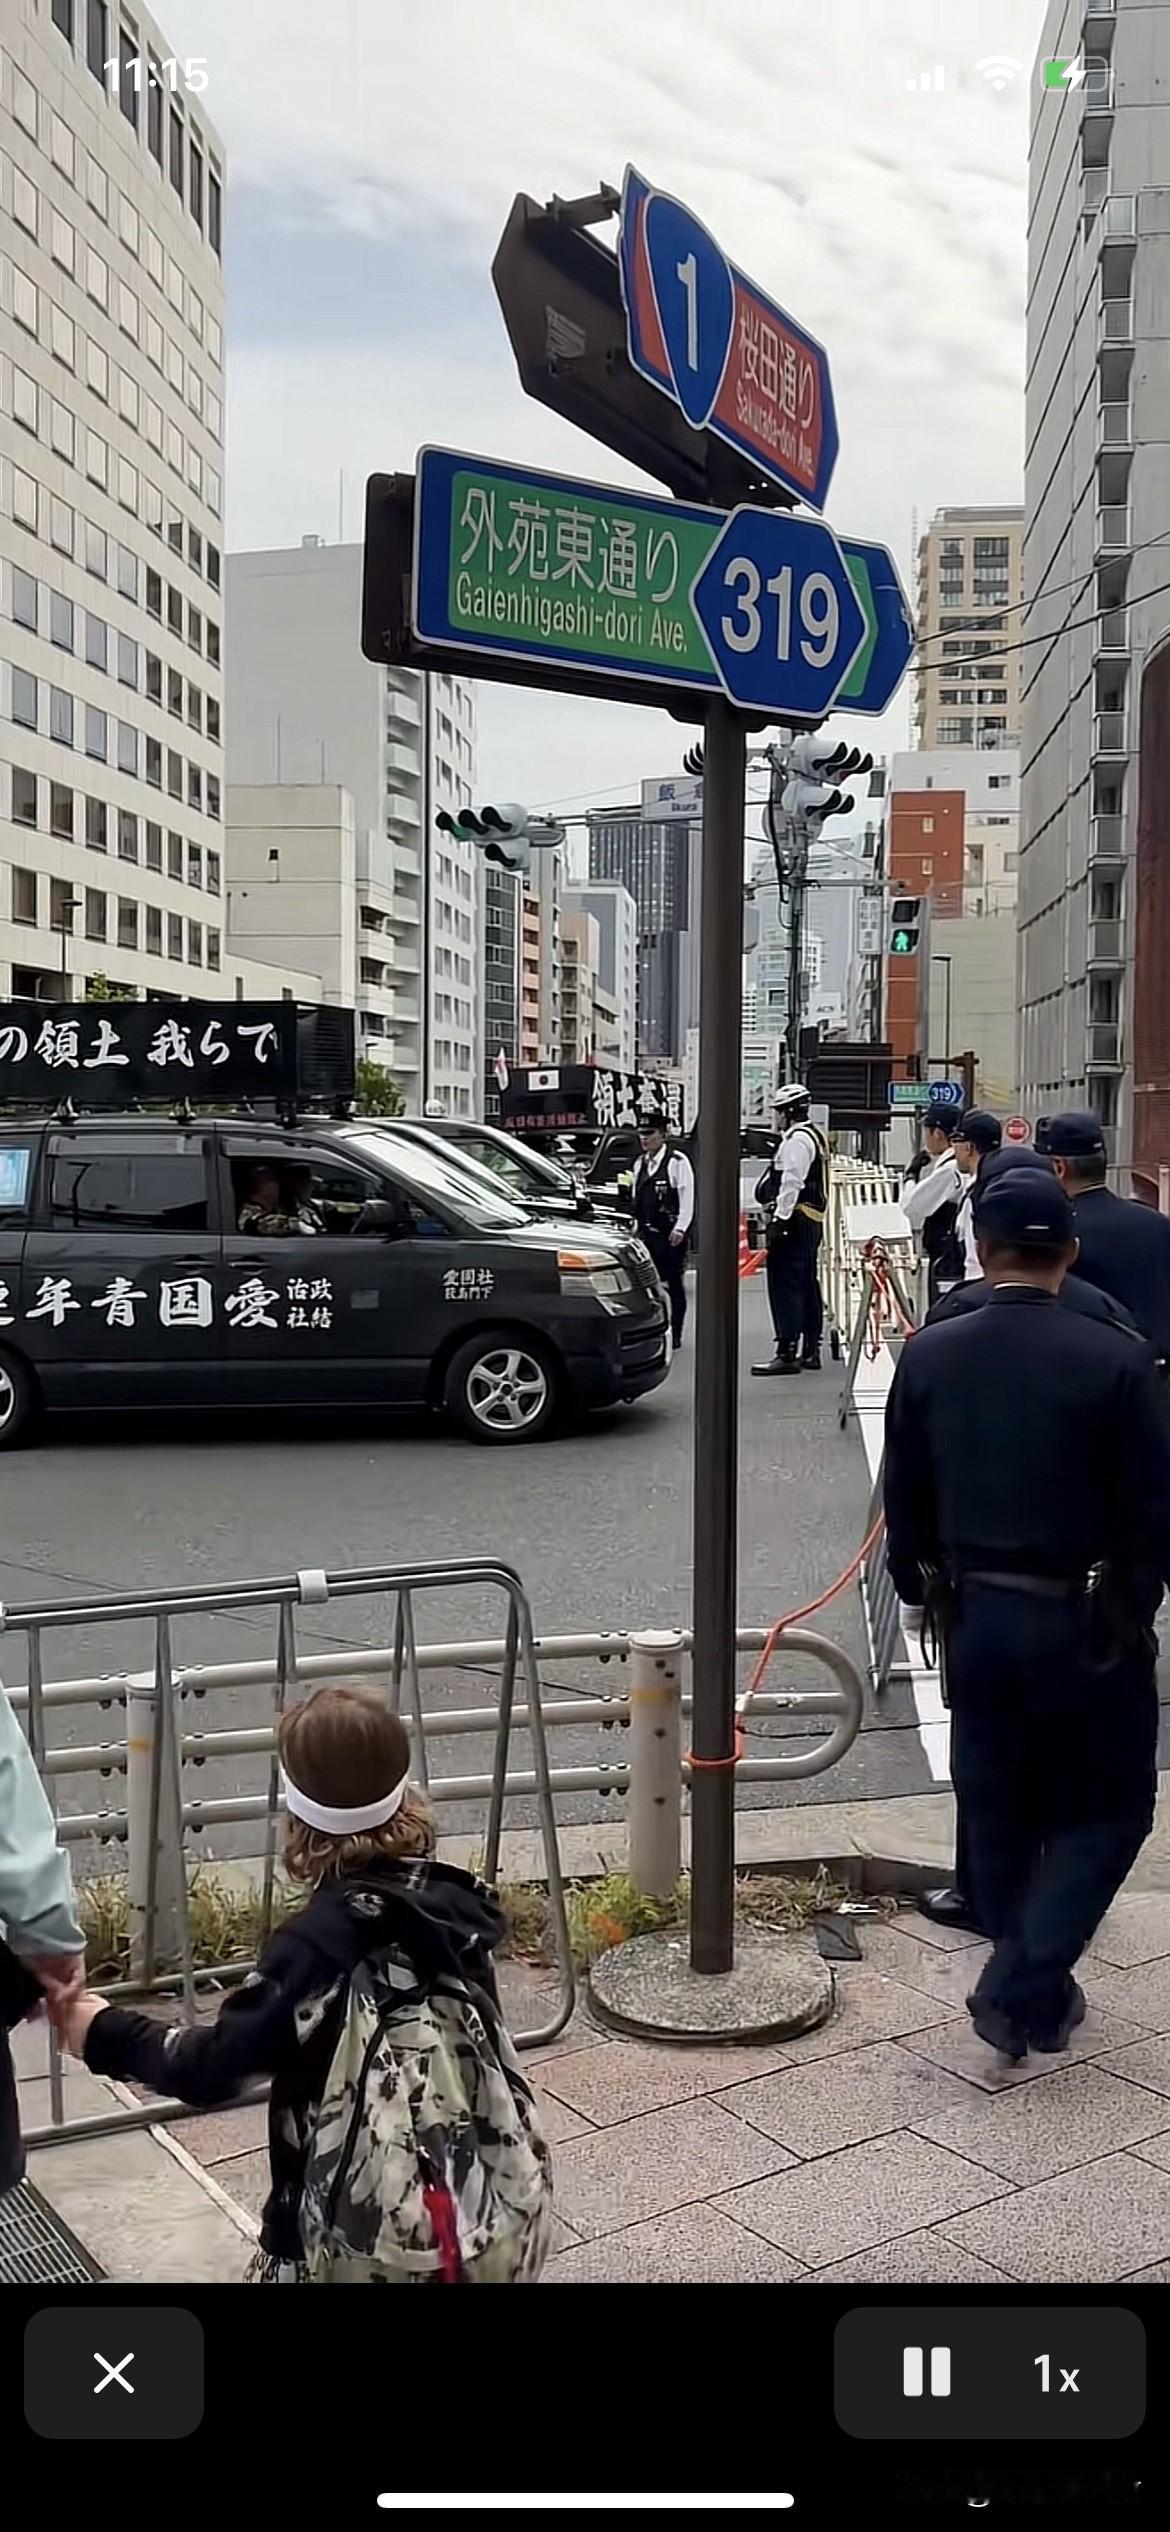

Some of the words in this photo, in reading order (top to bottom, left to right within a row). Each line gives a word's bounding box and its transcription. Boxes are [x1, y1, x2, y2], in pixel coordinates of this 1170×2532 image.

[677, 252, 698, 373] 1
[738, 302, 815, 428] 桜田通り
[736, 379, 796, 464] Sakurada-dori
[799, 431, 815, 476] Ave.
[458, 487, 681, 603] 外苑東通り
[455, 571, 643, 646] Gaienhigashi-dori
[650, 610, 688, 653] Ave.
[720, 557, 840, 669] 319
[0, 1019, 131, 1069] の領土
[146, 1018, 279, 1068] 我らで
[931, 1087, 951, 1100] 319
